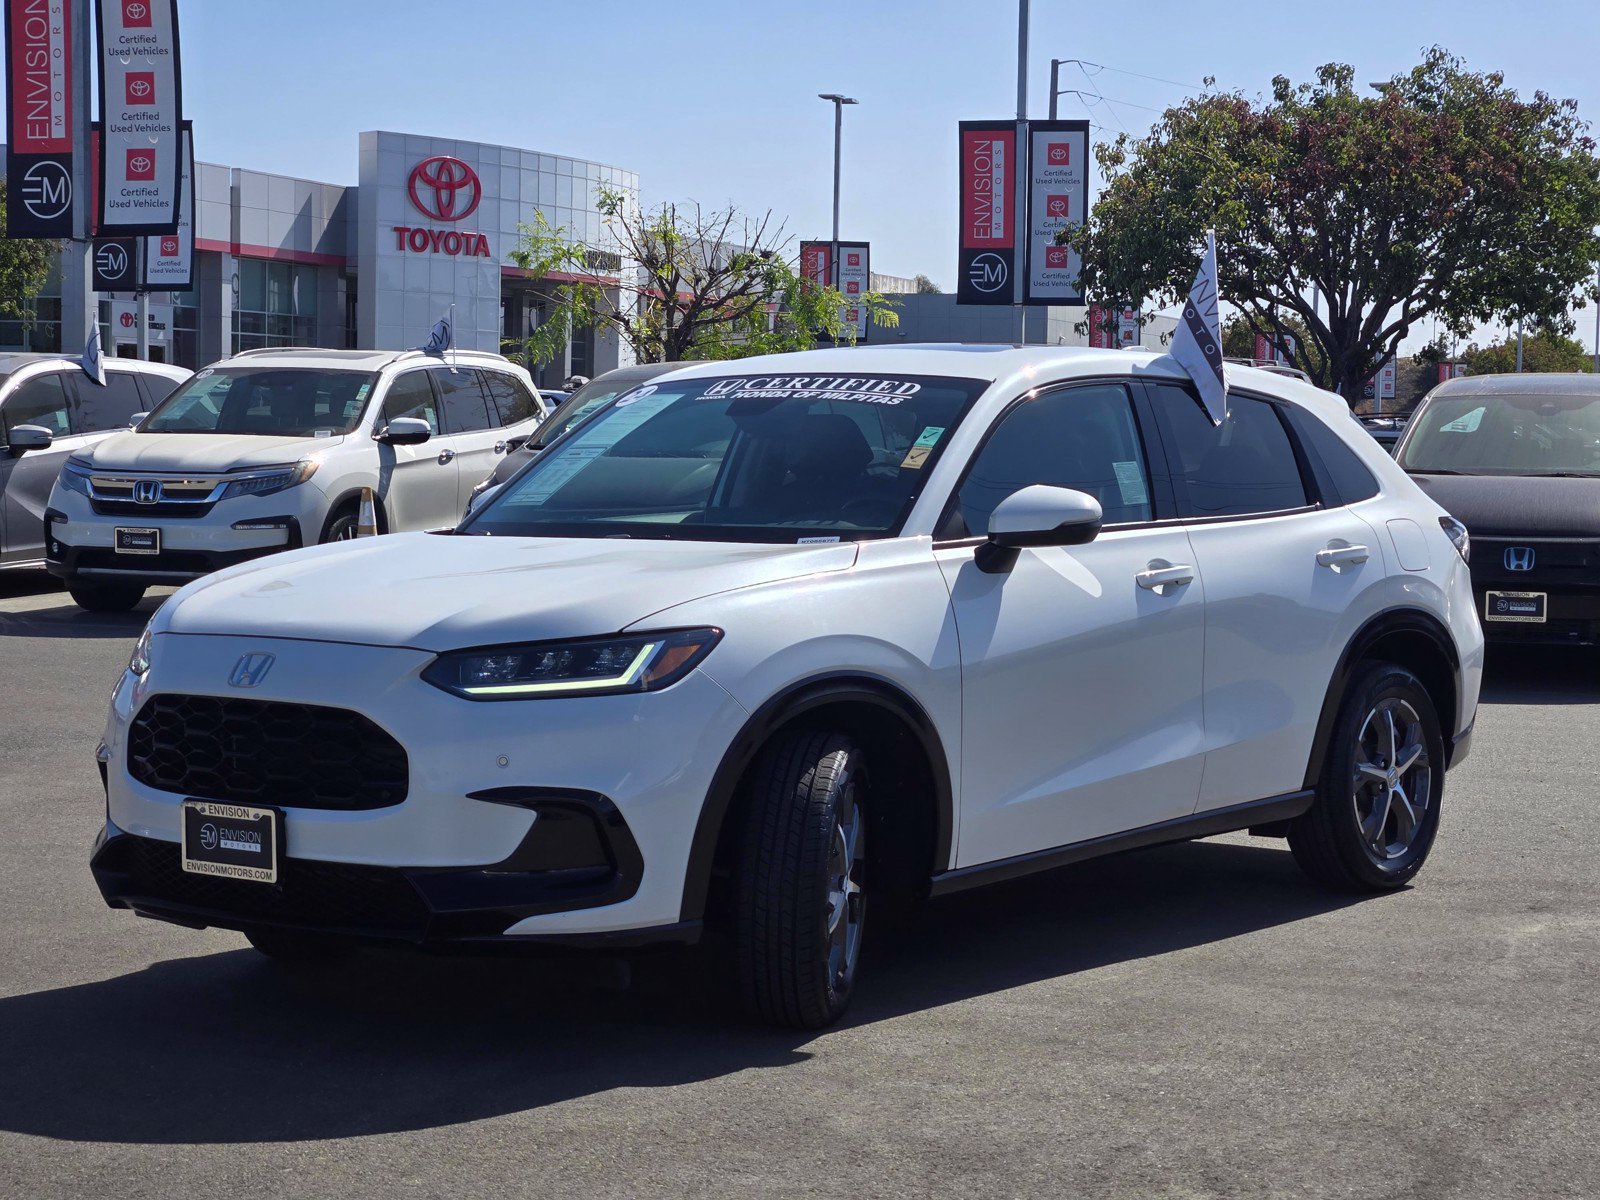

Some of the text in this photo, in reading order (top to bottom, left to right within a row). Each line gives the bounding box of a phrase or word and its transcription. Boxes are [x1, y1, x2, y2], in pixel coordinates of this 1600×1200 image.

[119, 35, 157, 44] Certified
[108, 47, 169, 56] Used Vehicles
[25, 0, 49, 139] ENVISION
[53, 6, 63, 126] MOTORS
[121, 112, 160, 121] Certified
[110, 123, 171, 133] Used Vehicles
[1043, 169, 1073, 177] Certified
[120, 188, 159, 197] Certified
[973, 140, 991, 239] ENVISION
[994, 149, 1002, 230] MOTORS
[109, 199, 170, 208] Used Vehicles
[393, 226, 491, 258] TOYOTA
[745, 377, 922, 395] CERTIFIED
[730, 391, 790, 399] HONDA
[819, 391, 905, 405] MILPITAS
[208, 804, 250, 819] ENVISION
[220, 828, 262, 843] ENVISION
[223, 841, 258, 850] MOTORS
[186, 861, 273, 881] ENVISIONMOTORS.COM
